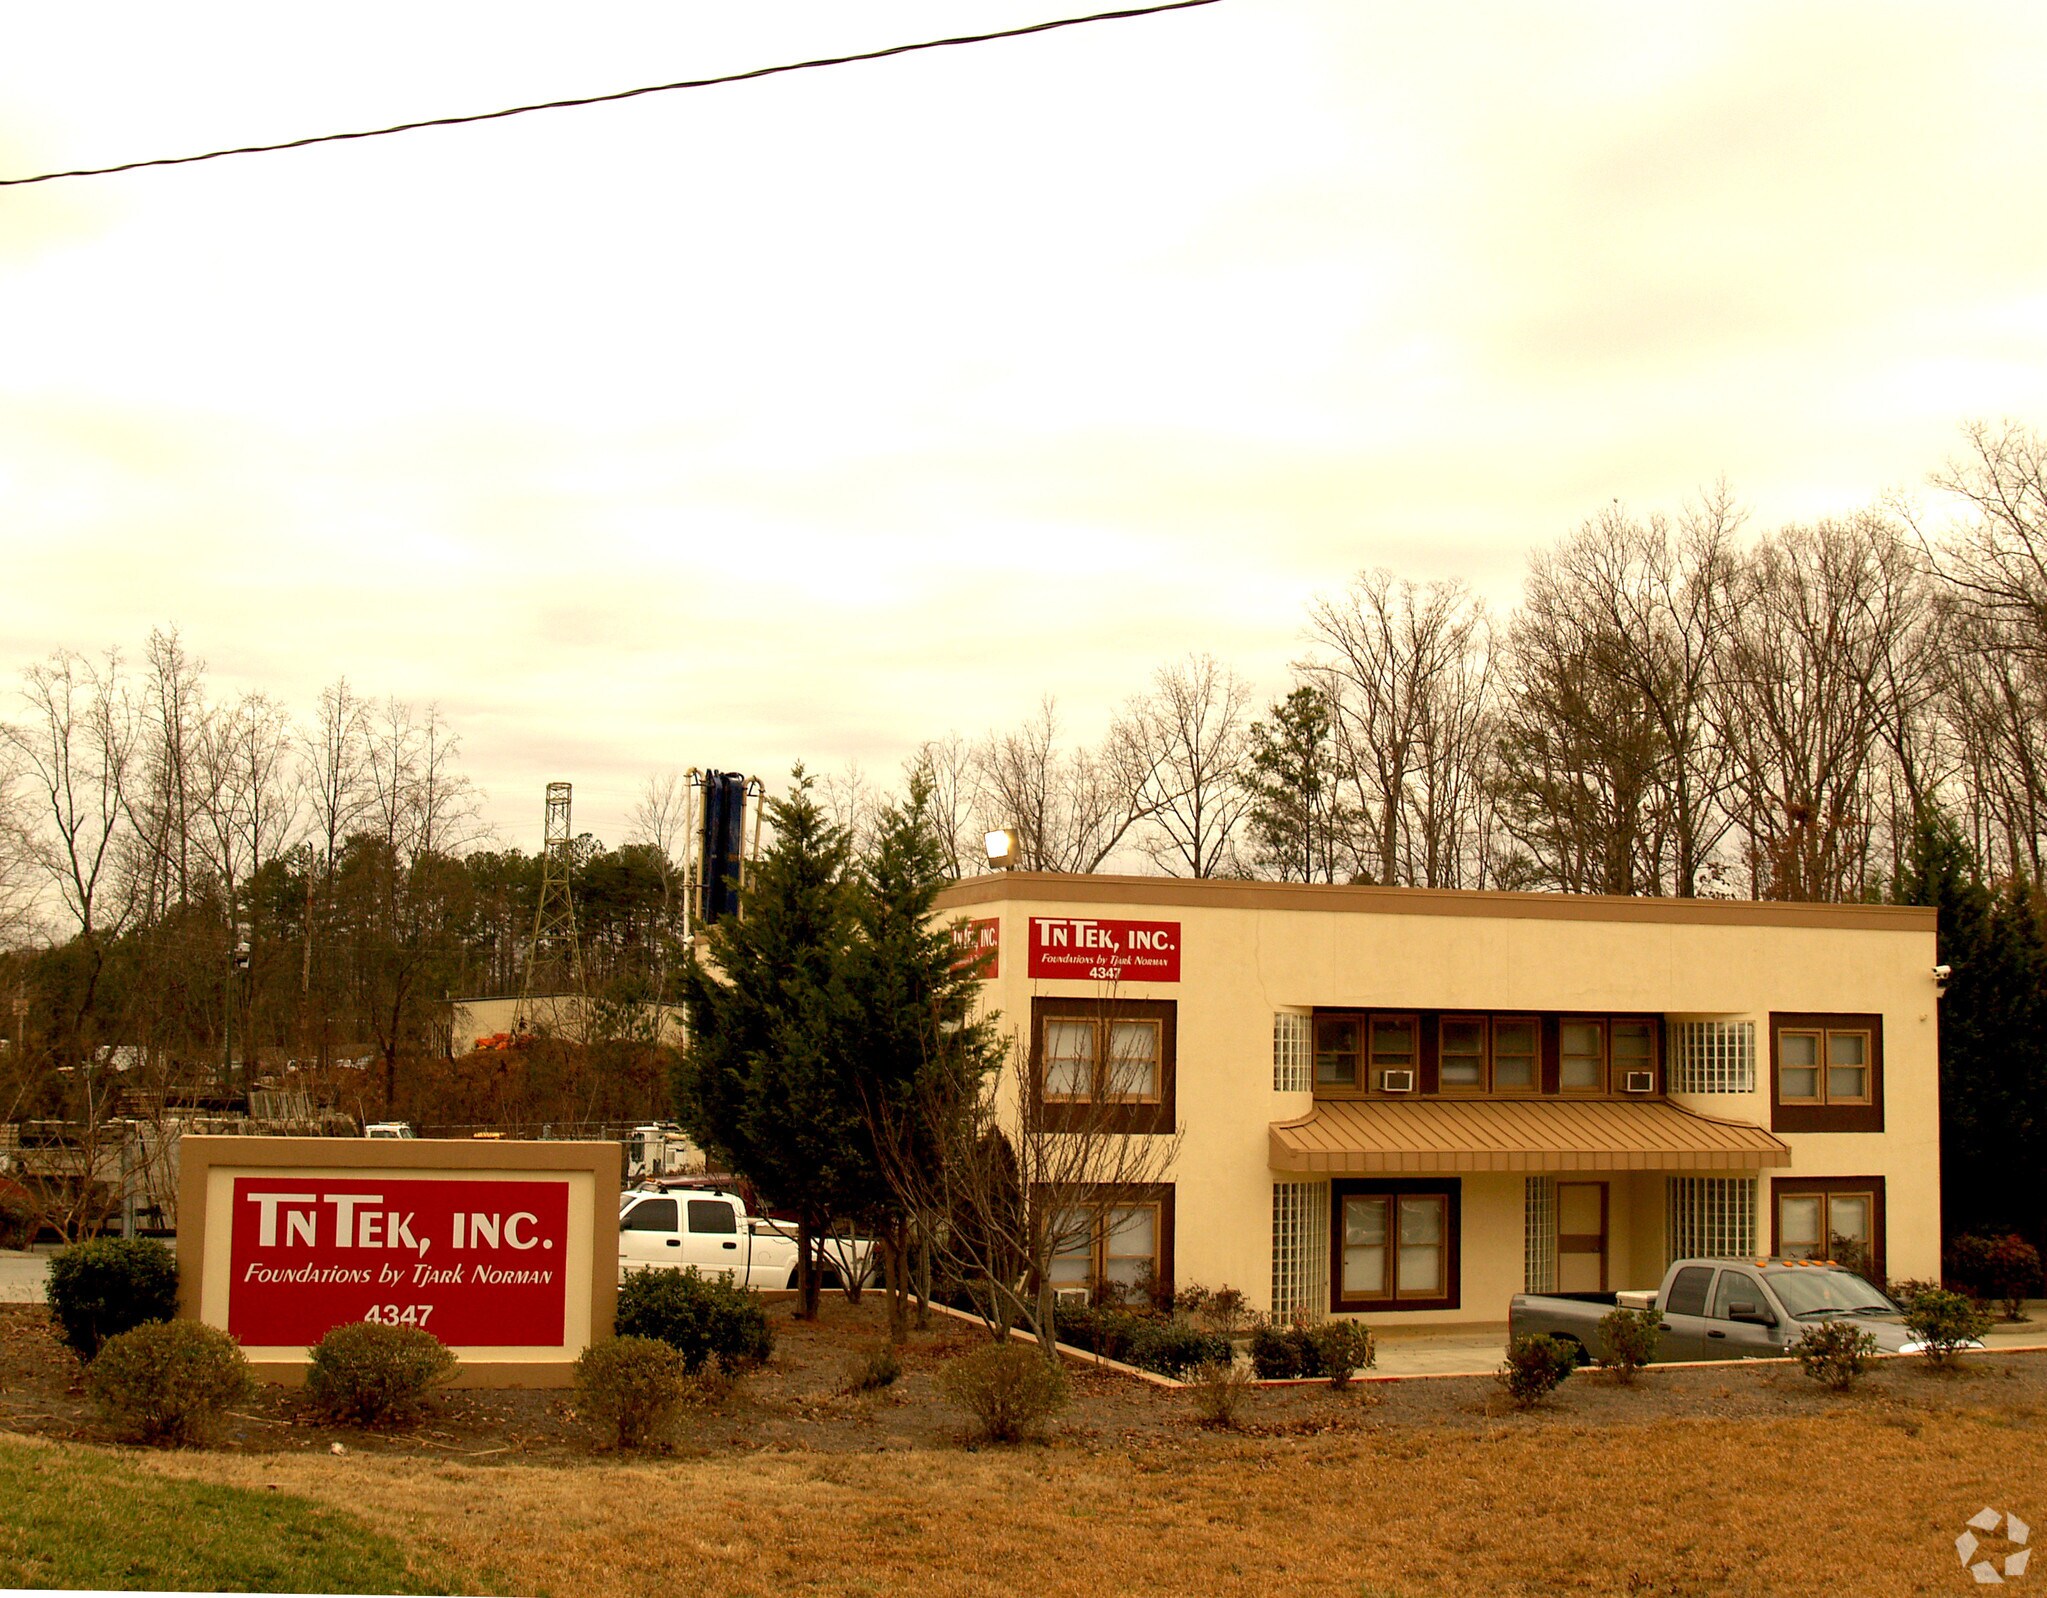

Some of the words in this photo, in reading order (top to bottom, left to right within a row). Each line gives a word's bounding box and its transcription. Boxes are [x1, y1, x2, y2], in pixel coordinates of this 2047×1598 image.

[1128, 930, 1175, 951] INC.
[1096, 954, 1107, 966] by
[1089, 967, 1121, 979] 4347
[452, 1211, 553, 1250] INC.
[378, 1263, 405, 1287] by
[364, 1304, 434, 1327] 4347
